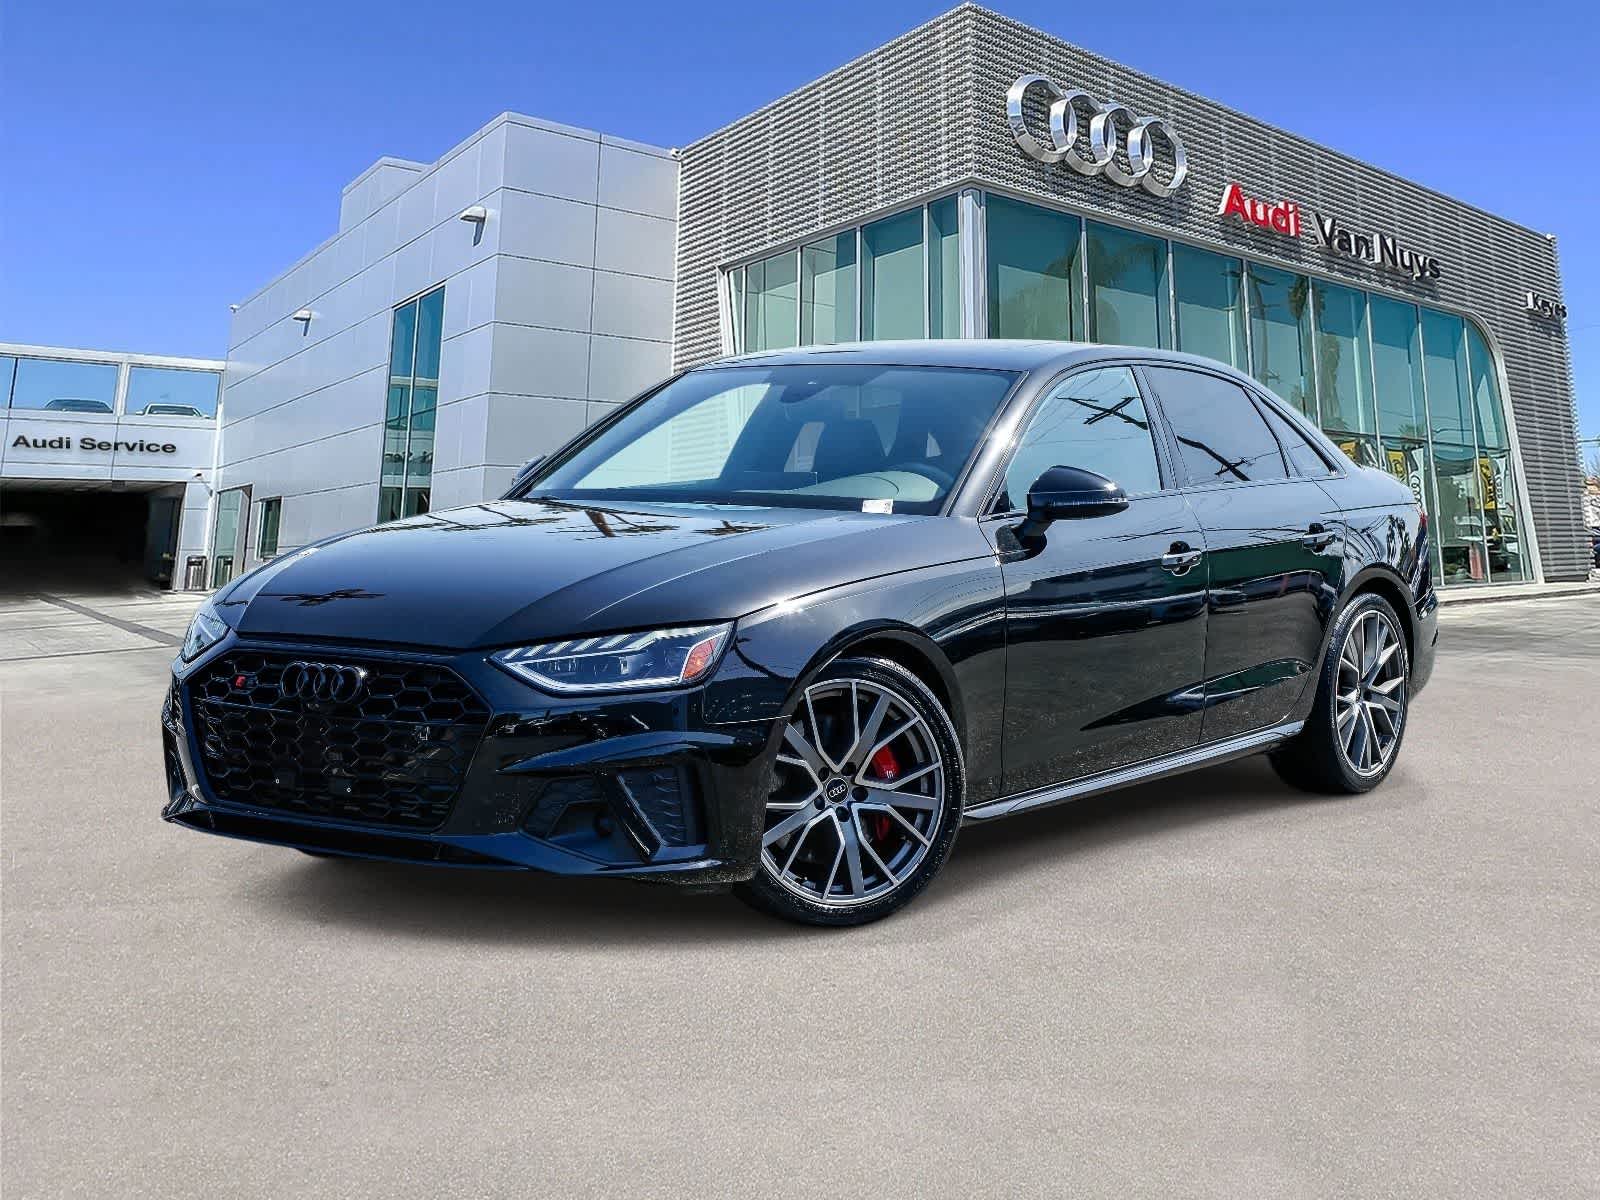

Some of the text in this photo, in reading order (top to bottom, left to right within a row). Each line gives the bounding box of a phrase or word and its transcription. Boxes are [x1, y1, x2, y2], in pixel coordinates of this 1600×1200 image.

[1217, 182, 1441, 280] Audi Van Nuys
[12, 434, 177, 454] Audi Service
